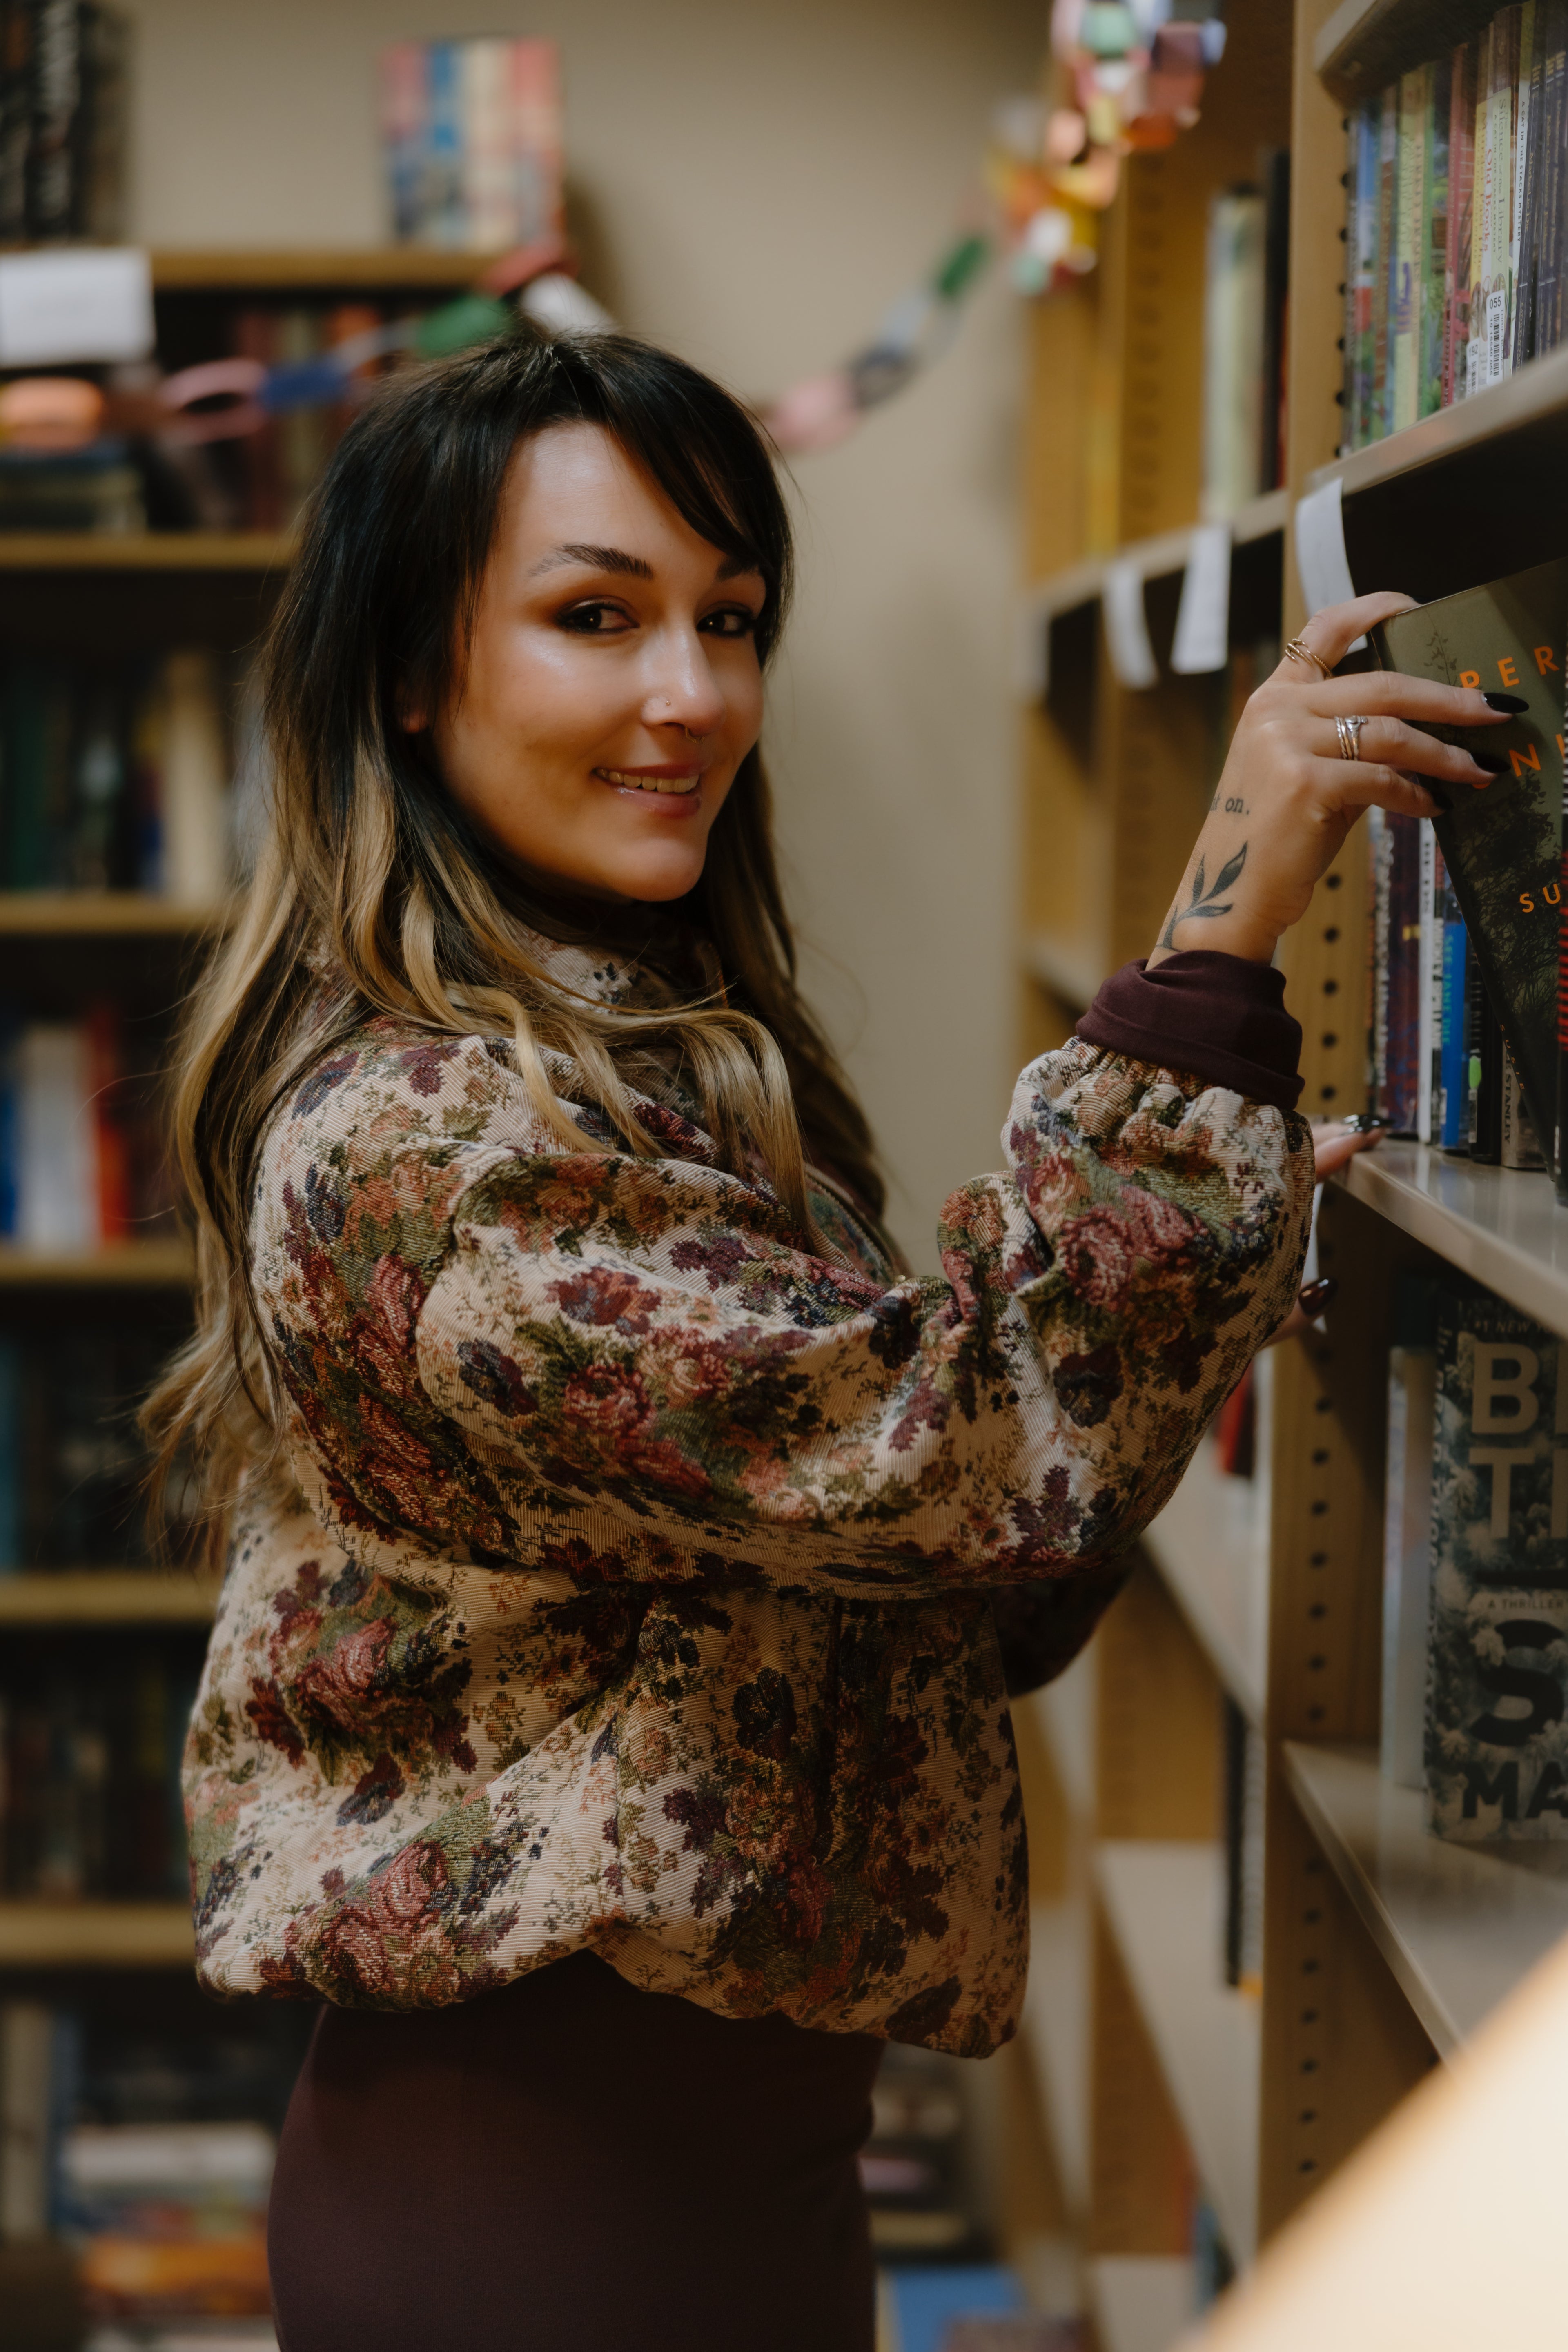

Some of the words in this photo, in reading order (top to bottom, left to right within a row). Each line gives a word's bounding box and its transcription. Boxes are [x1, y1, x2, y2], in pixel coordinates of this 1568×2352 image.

[1521, 131, 1524, 140] IN
[1483, 193, 1492, 252] Books
[1496, 198, 1506, 264] Library
[1490, 296, 1501, 310] 055
[1459, 646, 1559, 689] PER
[1519, 883, 1561, 913] SU
[1443, 973, 1453, 1013] JANE
[1442, 1018, 1452, 1046] DIE
[1500, 1024, 1525, 1090] SUSIE
[1503, 1598, 1564, 1608] THRILLER
